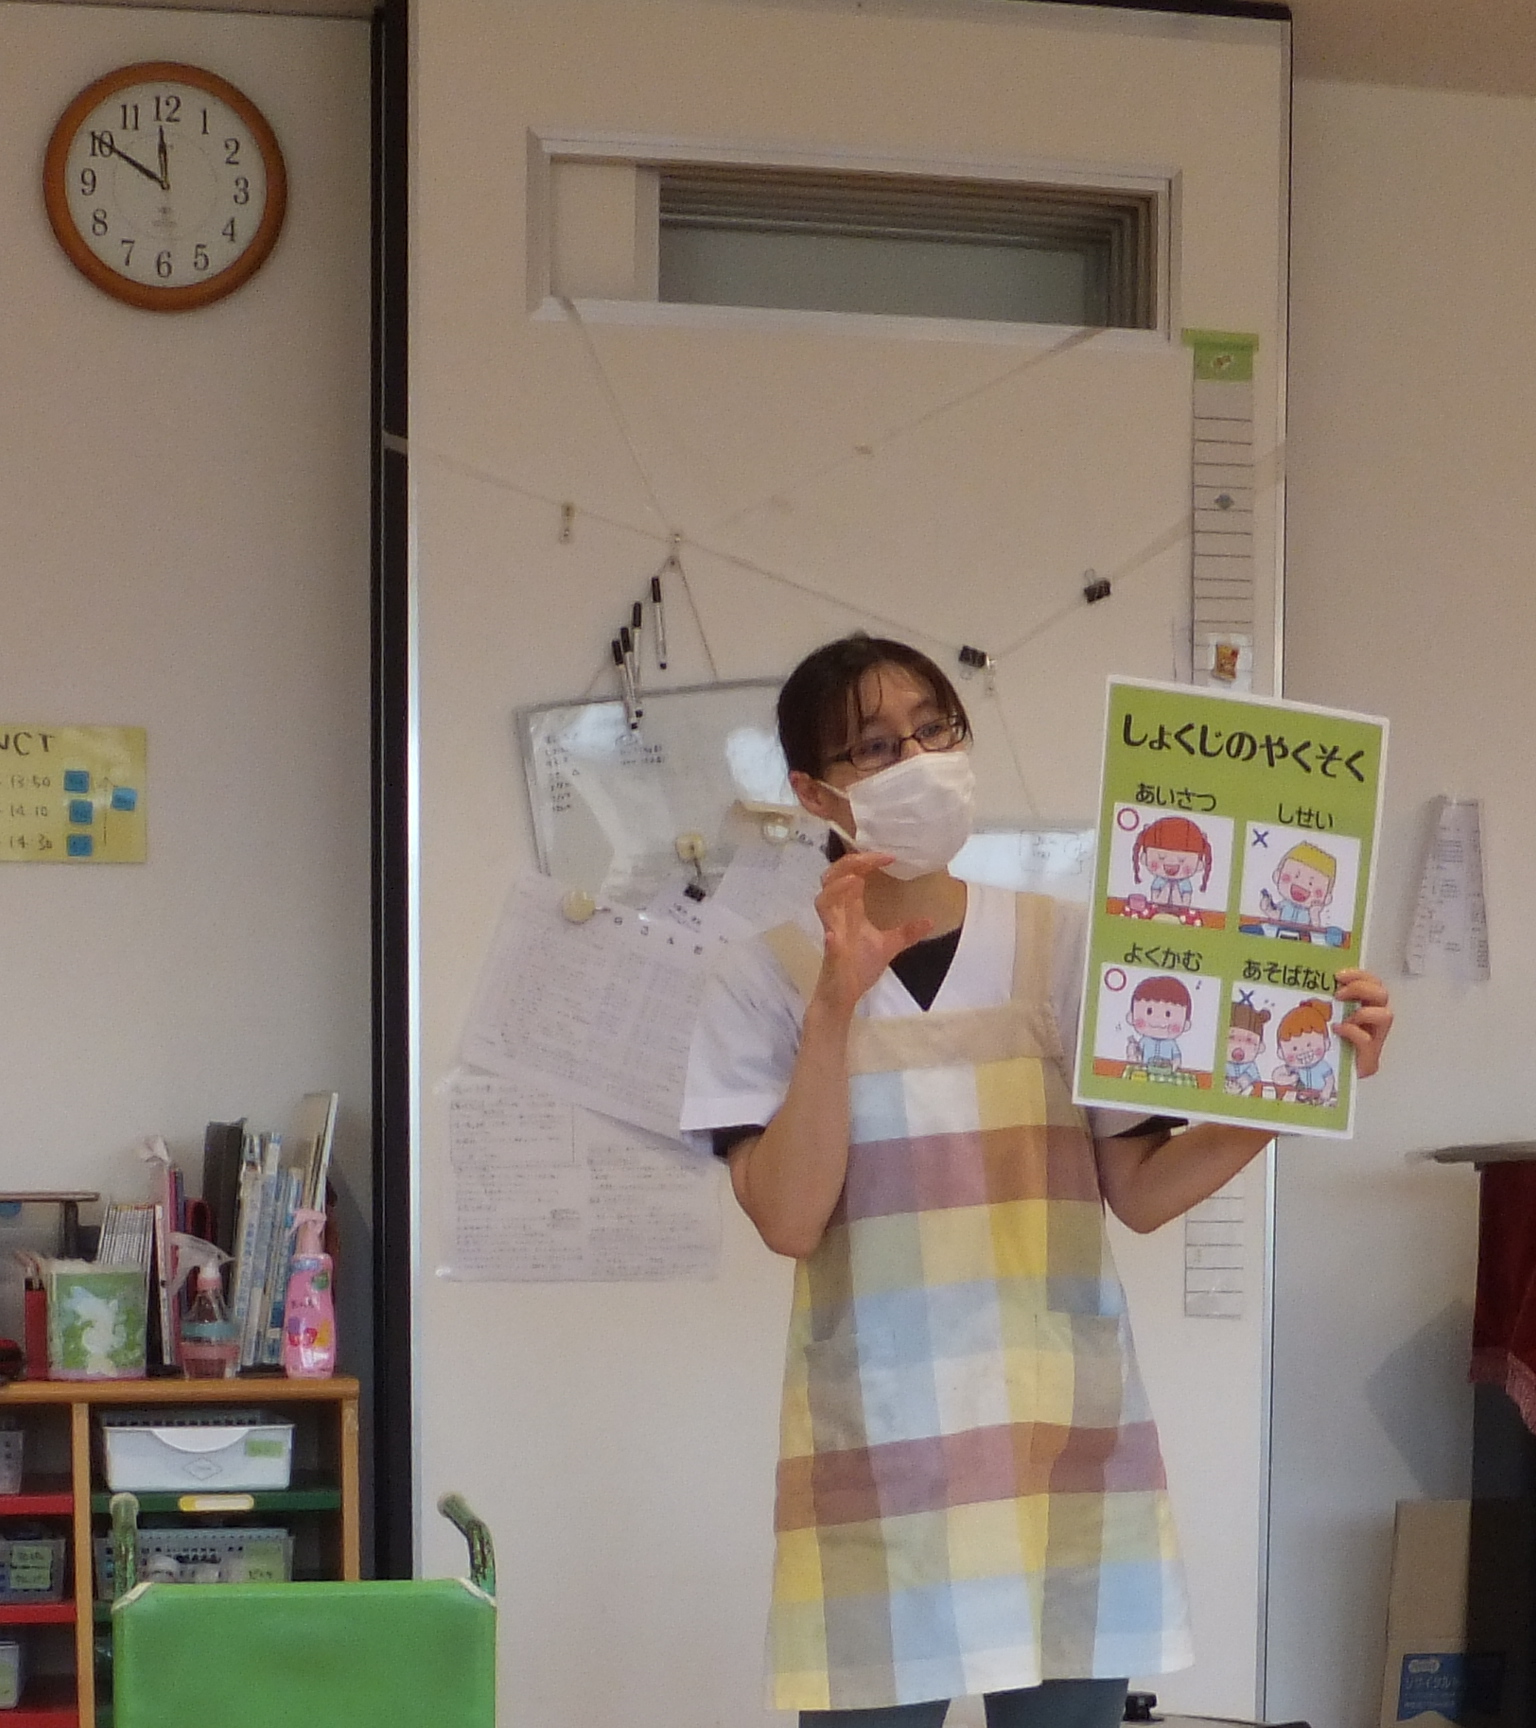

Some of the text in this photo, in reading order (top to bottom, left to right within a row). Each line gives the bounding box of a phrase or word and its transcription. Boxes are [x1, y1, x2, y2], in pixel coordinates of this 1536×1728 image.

[121, 104, 139, 131] 11
[153, 96, 181, 122] 12
[201, 108, 209, 135] 1
[89, 130, 114, 157] 10
[224, 138, 240, 165] 2
[80, 168, 97, 196] 9
[233, 177, 249, 204] 3
[92, 208, 108, 236] 8
[221, 217, 236, 242] 4
[121, 239, 135, 266] 7
[156, 251, 172, 278] 6
[193, 244, 209, 271] 5
[1122, 714, 1366, 782] しょくじのやくそく
[1134, 782, 1216, 812] あいさつ
[1278, 803, 1334, 829] しせい
[1123, 944, 1204, 971] よくかむ
[1242, 959, 1341, 992] あそばない
